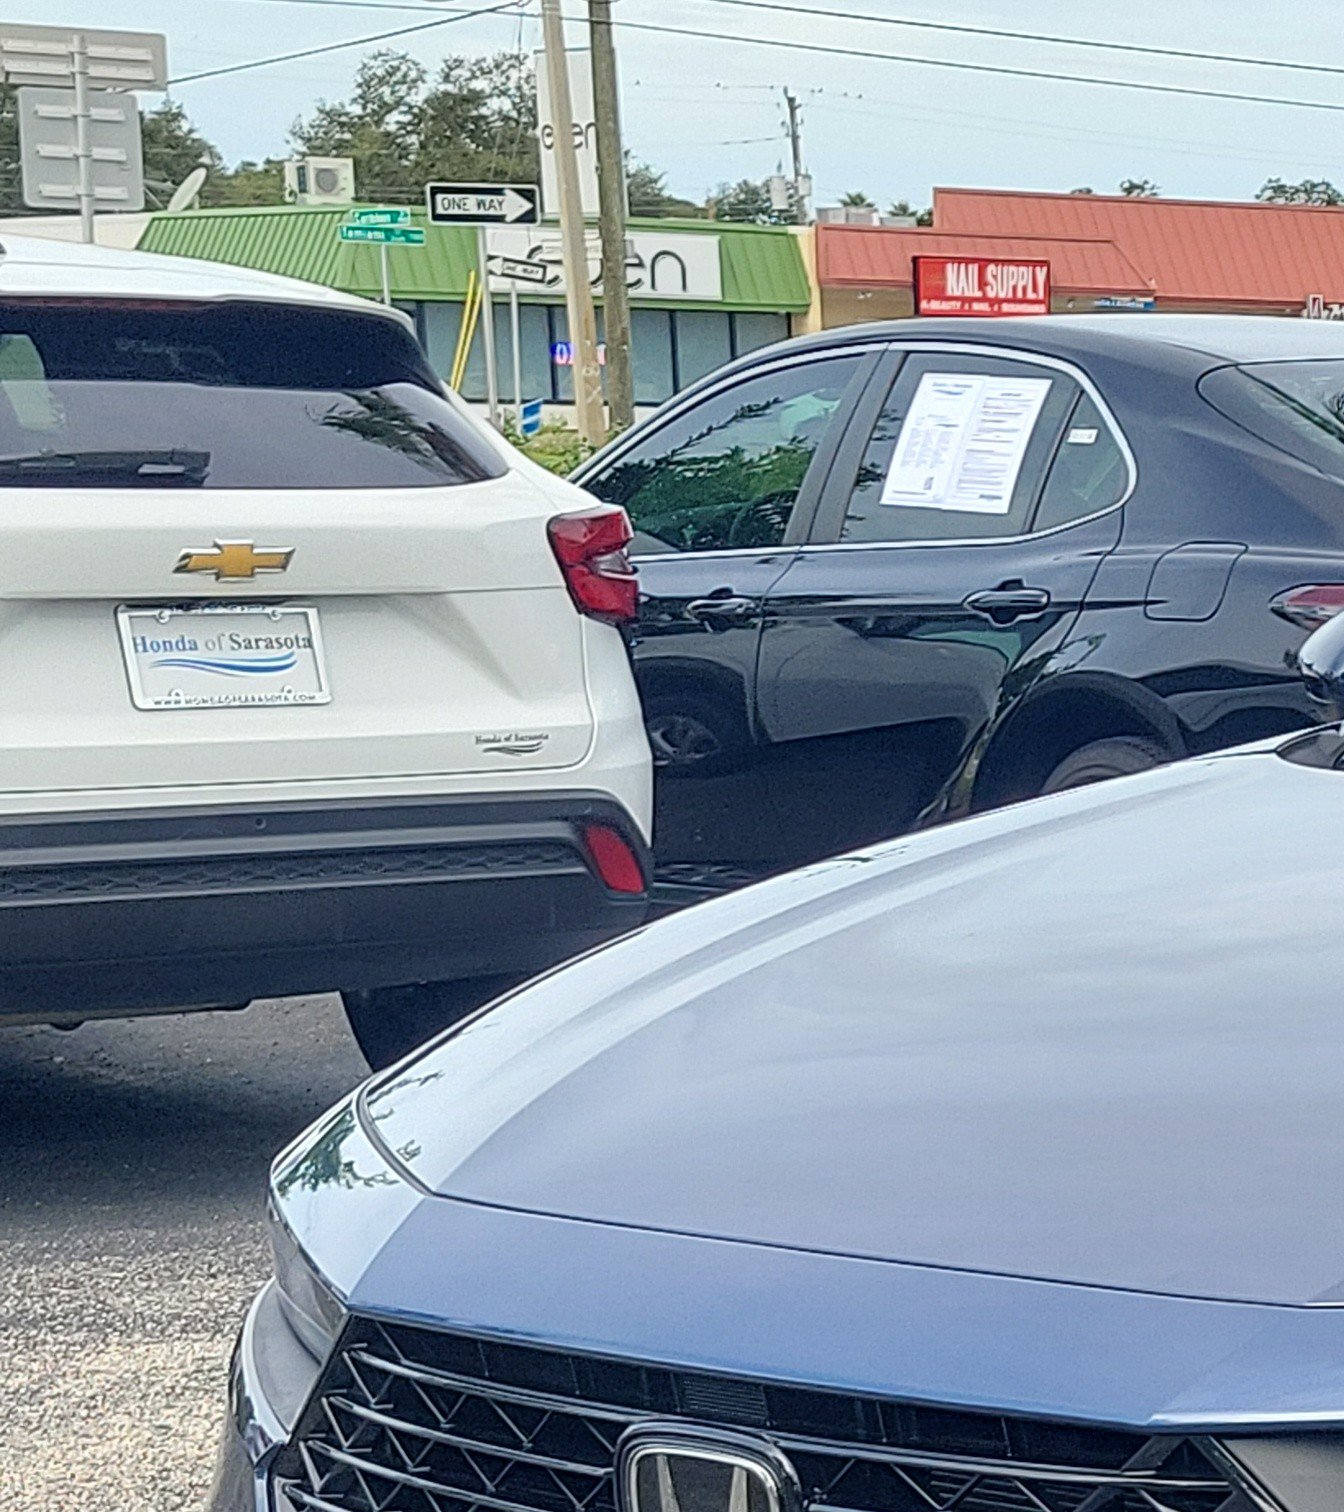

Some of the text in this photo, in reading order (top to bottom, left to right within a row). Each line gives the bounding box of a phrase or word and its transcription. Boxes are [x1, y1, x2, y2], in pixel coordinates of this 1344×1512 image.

[440, 196, 506, 212] ONE WAY
[946, 262, 1048, 300] NAIL SUPPLY
[134, 630, 313, 653] Honda of Sarasota
